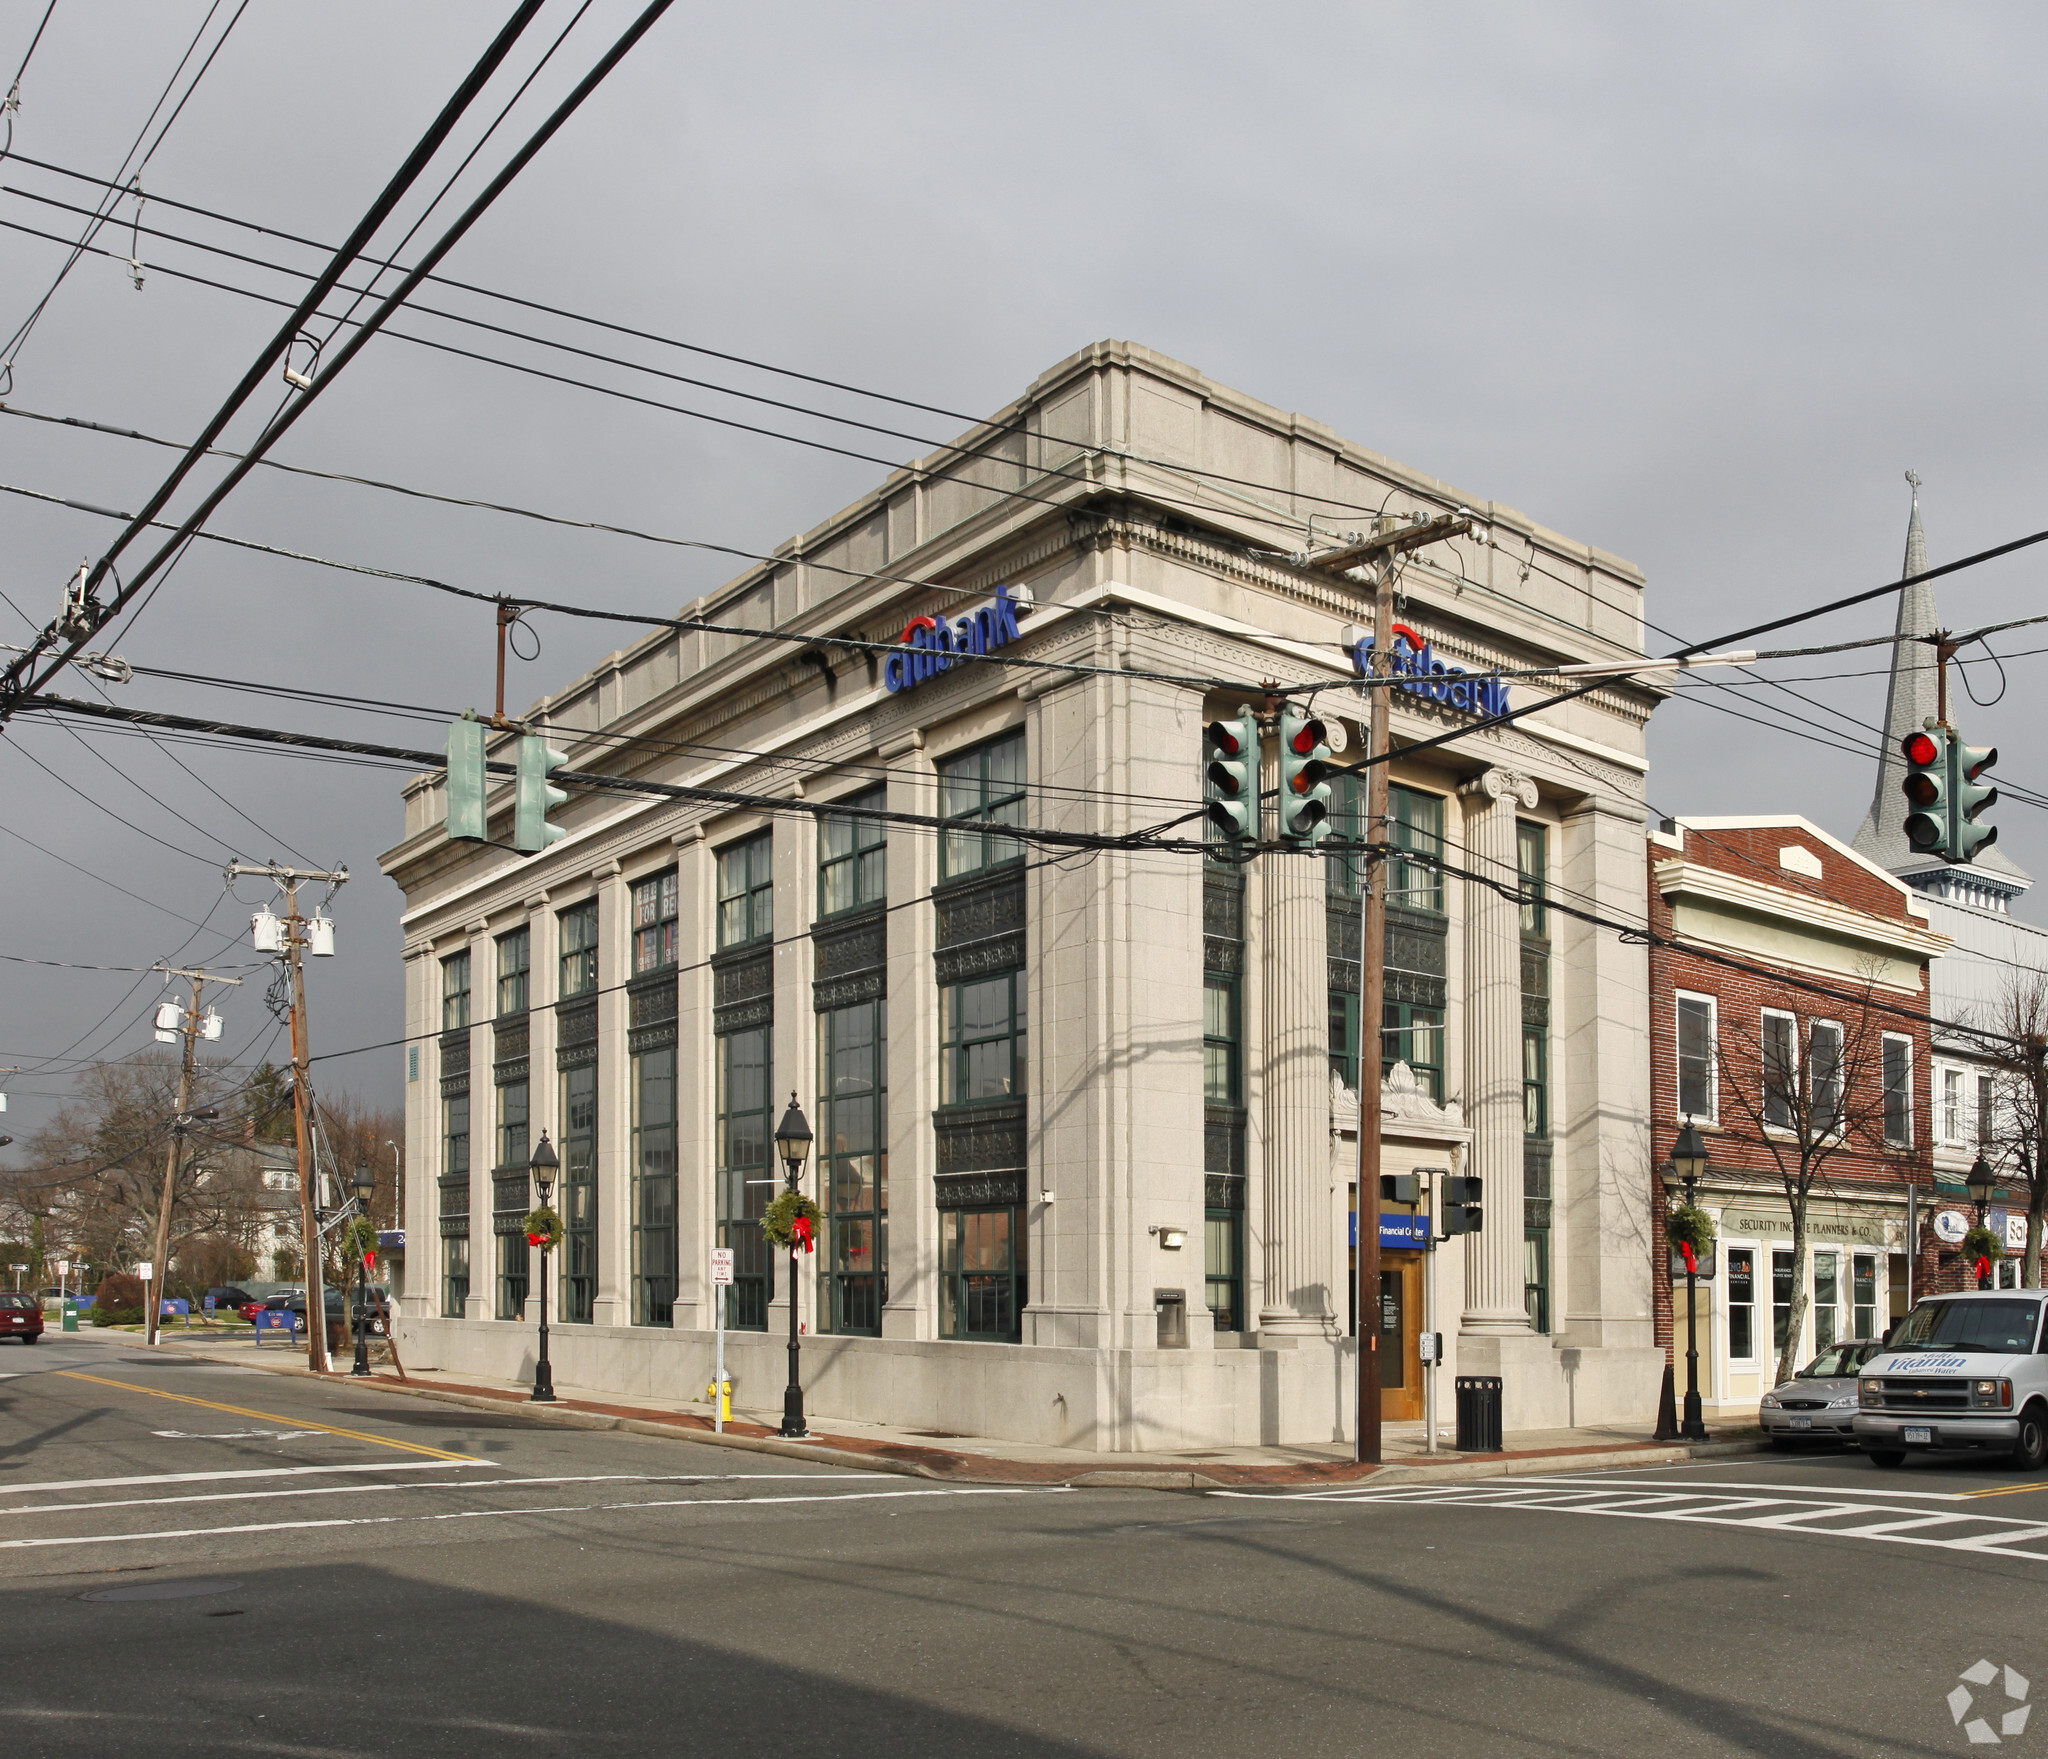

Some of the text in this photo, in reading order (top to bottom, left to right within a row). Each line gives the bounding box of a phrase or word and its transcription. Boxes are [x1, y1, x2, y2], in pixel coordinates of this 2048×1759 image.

[885, 584, 1021, 692] citibank
[1353, 623, 1513, 724] ctibank
[640, 903, 655, 925] FOR
[1379, 1226, 1424, 1237] Financial Ceter
[1739, 1219, 1871, 1237] SECURITY INCE PLANNERS & CO.
[1887, 1358, 1967, 1371] Vitamin
